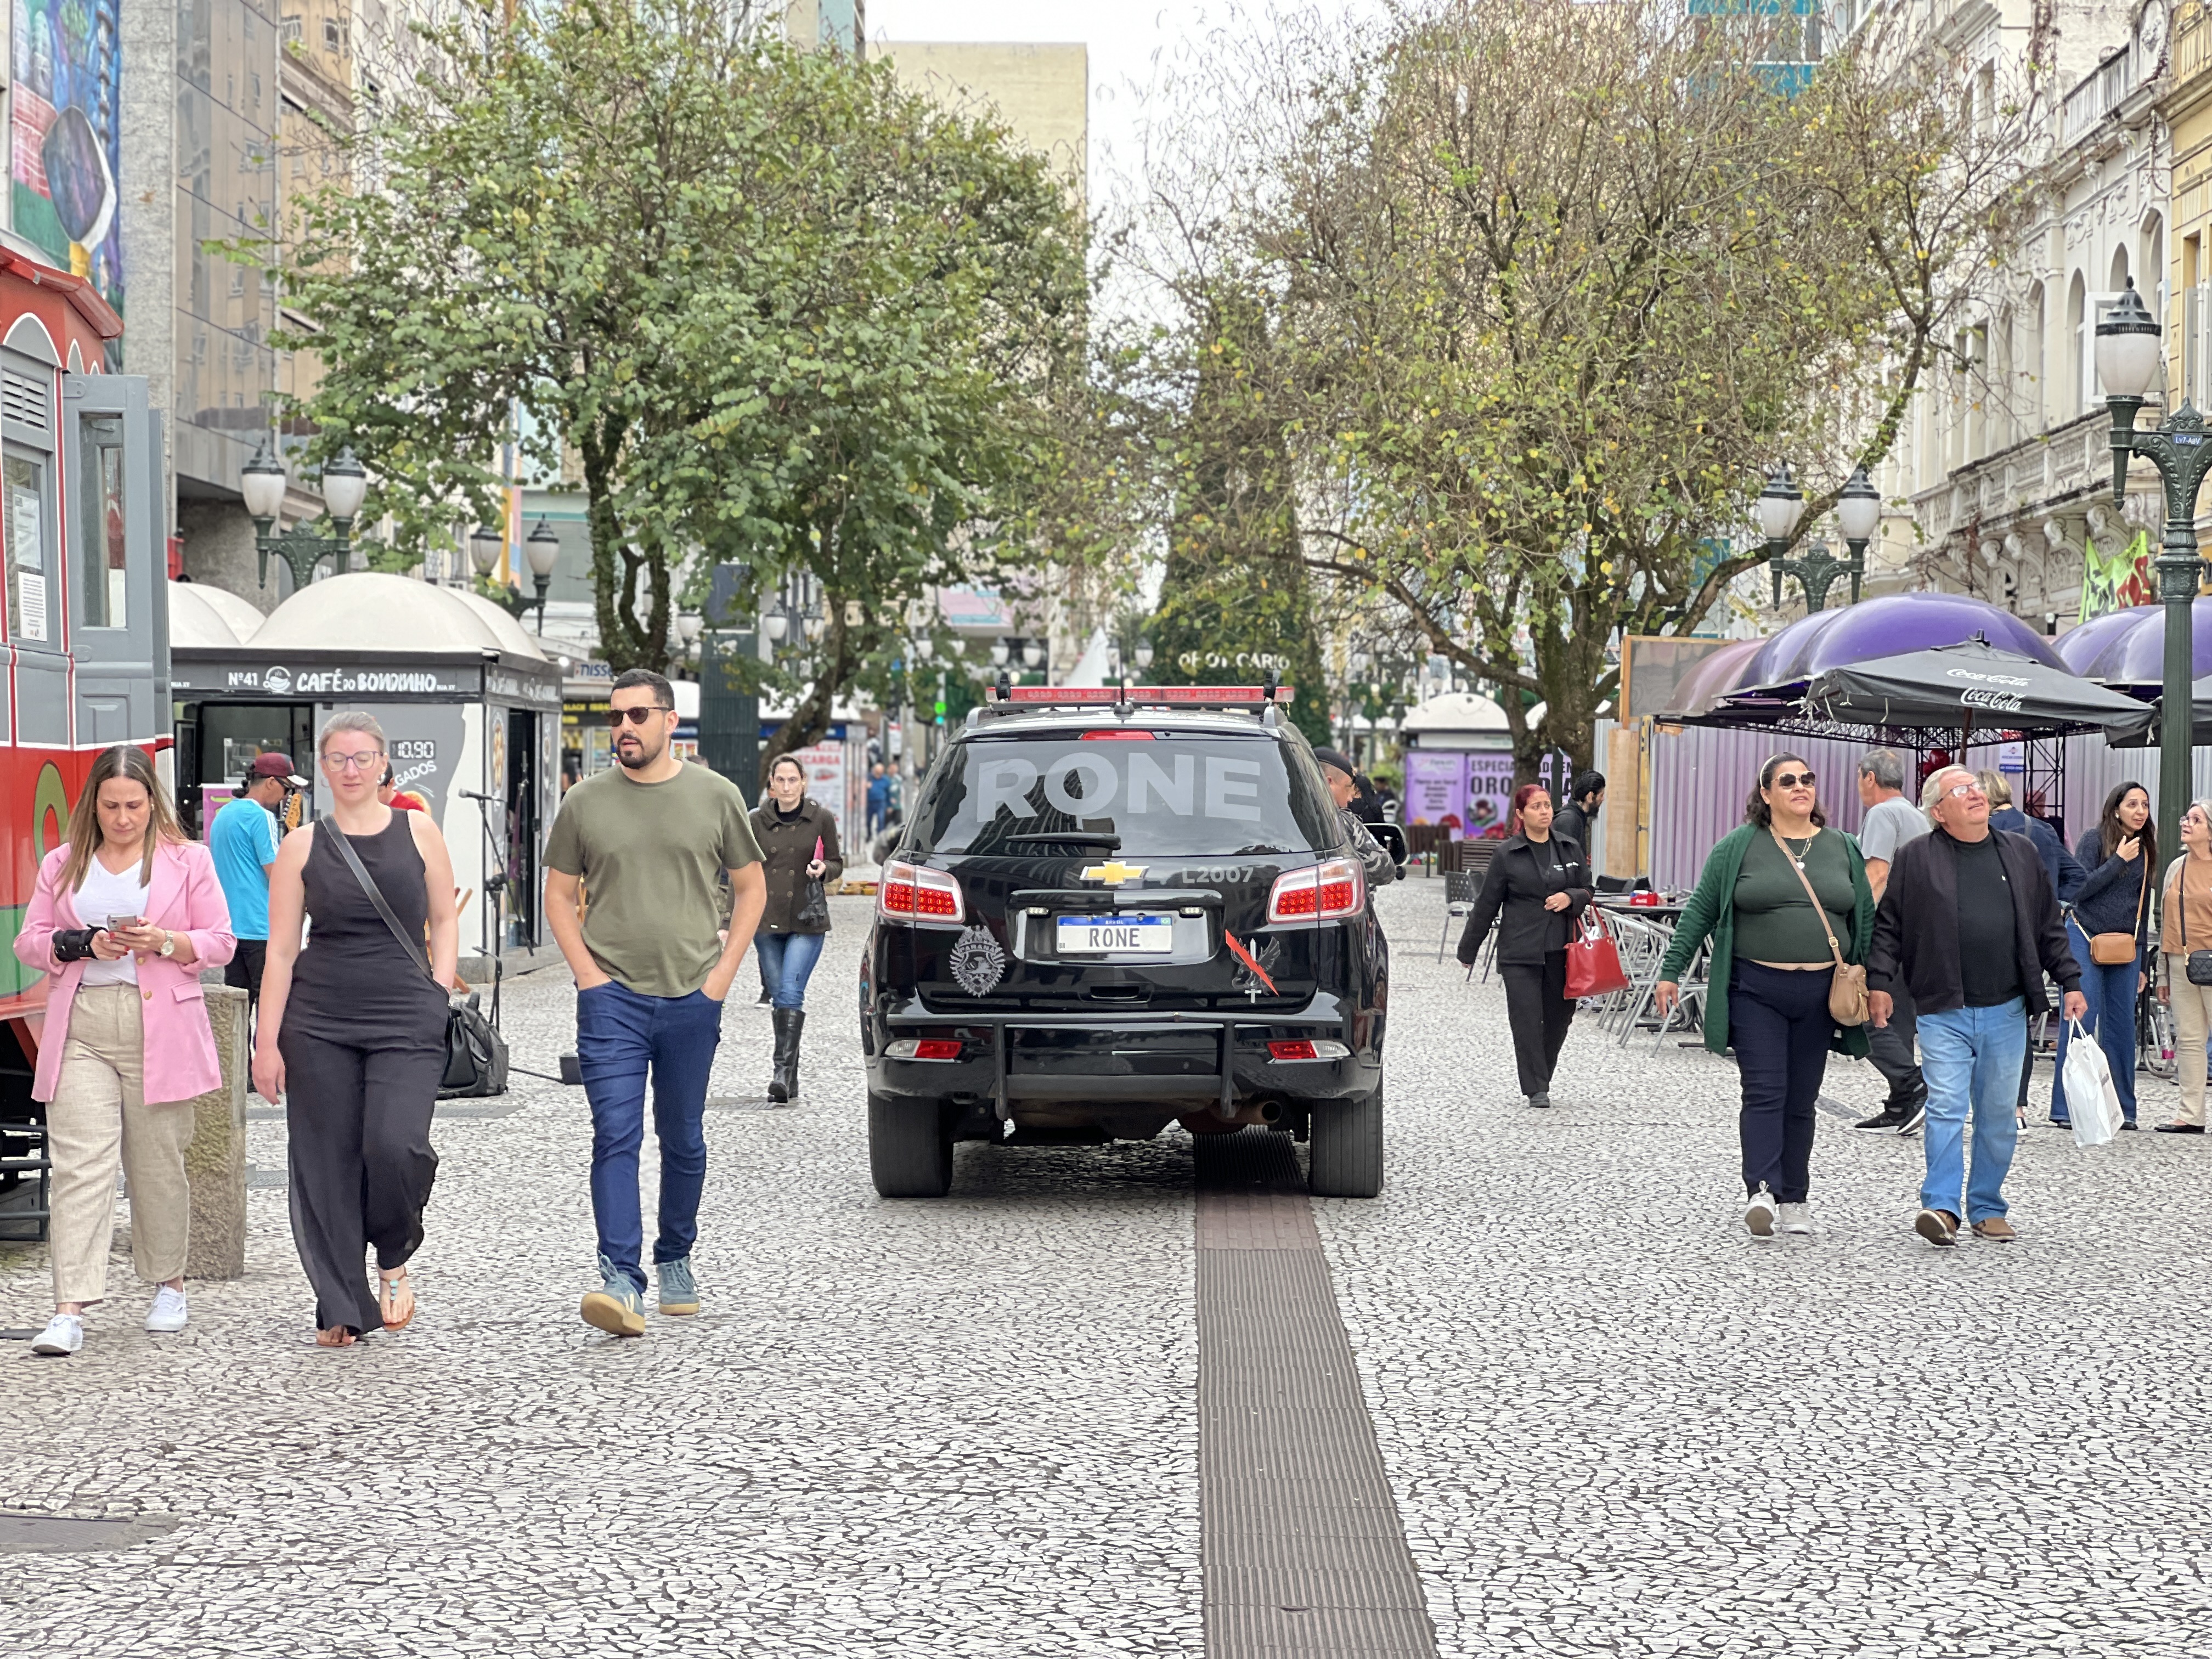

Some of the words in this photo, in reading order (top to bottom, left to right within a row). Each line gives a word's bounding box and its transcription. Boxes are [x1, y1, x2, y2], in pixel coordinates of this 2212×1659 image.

[296, 668, 342, 692] CAFÉ
[343, 679, 356, 691] DO
[357, 673, 437, 692] BONDINHO
[1946, 669, 2032, 686] Coca-Cola
[1960, 687, 2027, 712] Coca-Cola
[398, 741, 434, 758] 10,90
[391, 760, 437, 790] GADOS
[977, 752, 1261, 822] RONE
[1182, 866, 1254, 883] L2007
[1089, 928, 1140, 947] RONE
